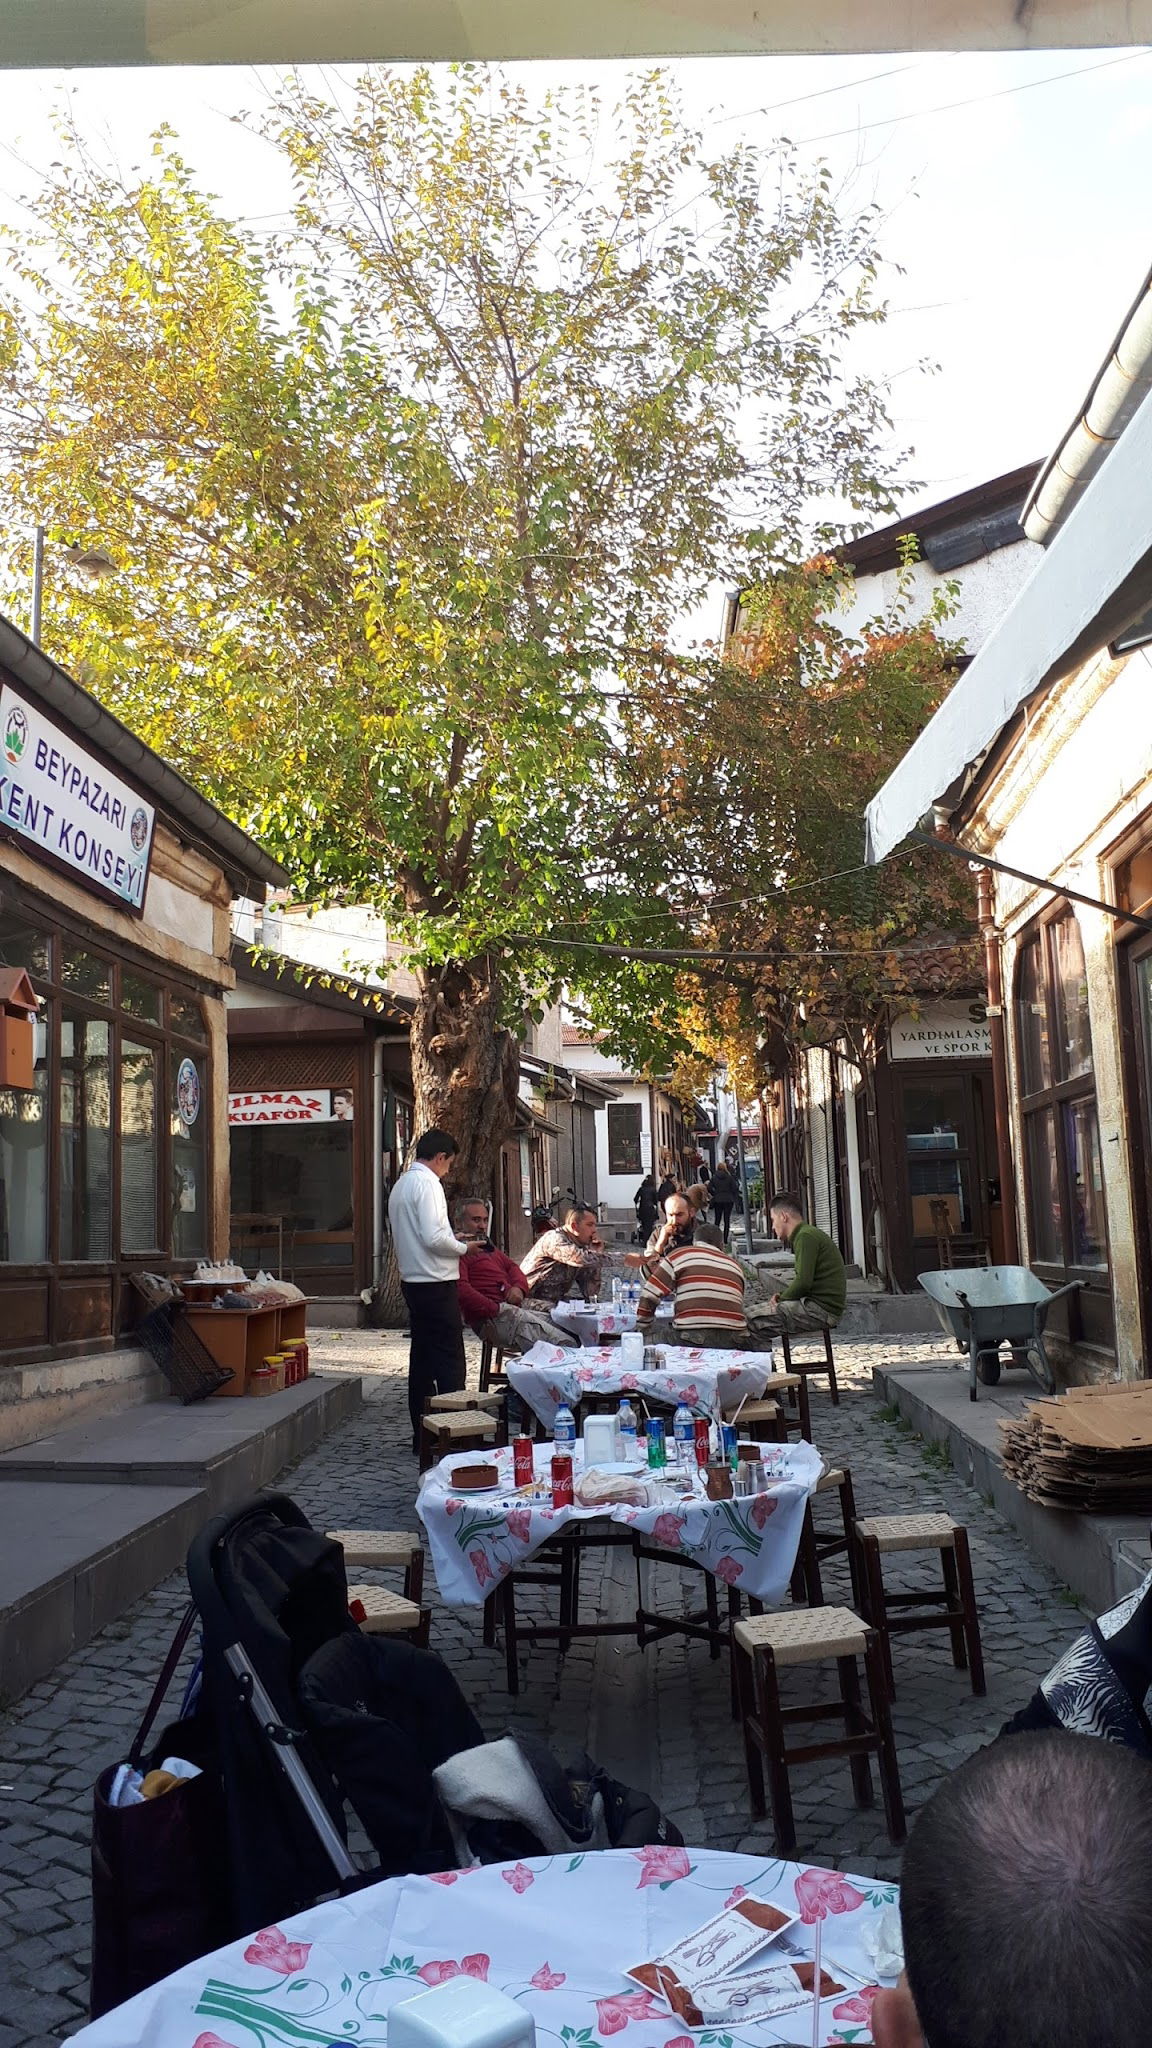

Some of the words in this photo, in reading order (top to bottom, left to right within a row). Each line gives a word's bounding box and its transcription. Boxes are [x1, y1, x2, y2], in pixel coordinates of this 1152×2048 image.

[35, 738, 127, 831] BEYPAZARI
[58, 818, 143, 898] KONSEYİ
[924, 1045, 941, 1054] VE
[944, 1042, 979, 1053] SPOR
[228, 1094, 322, 1113] ILMAZ
[228, 1108, 313, 1122] KUAFÖR
